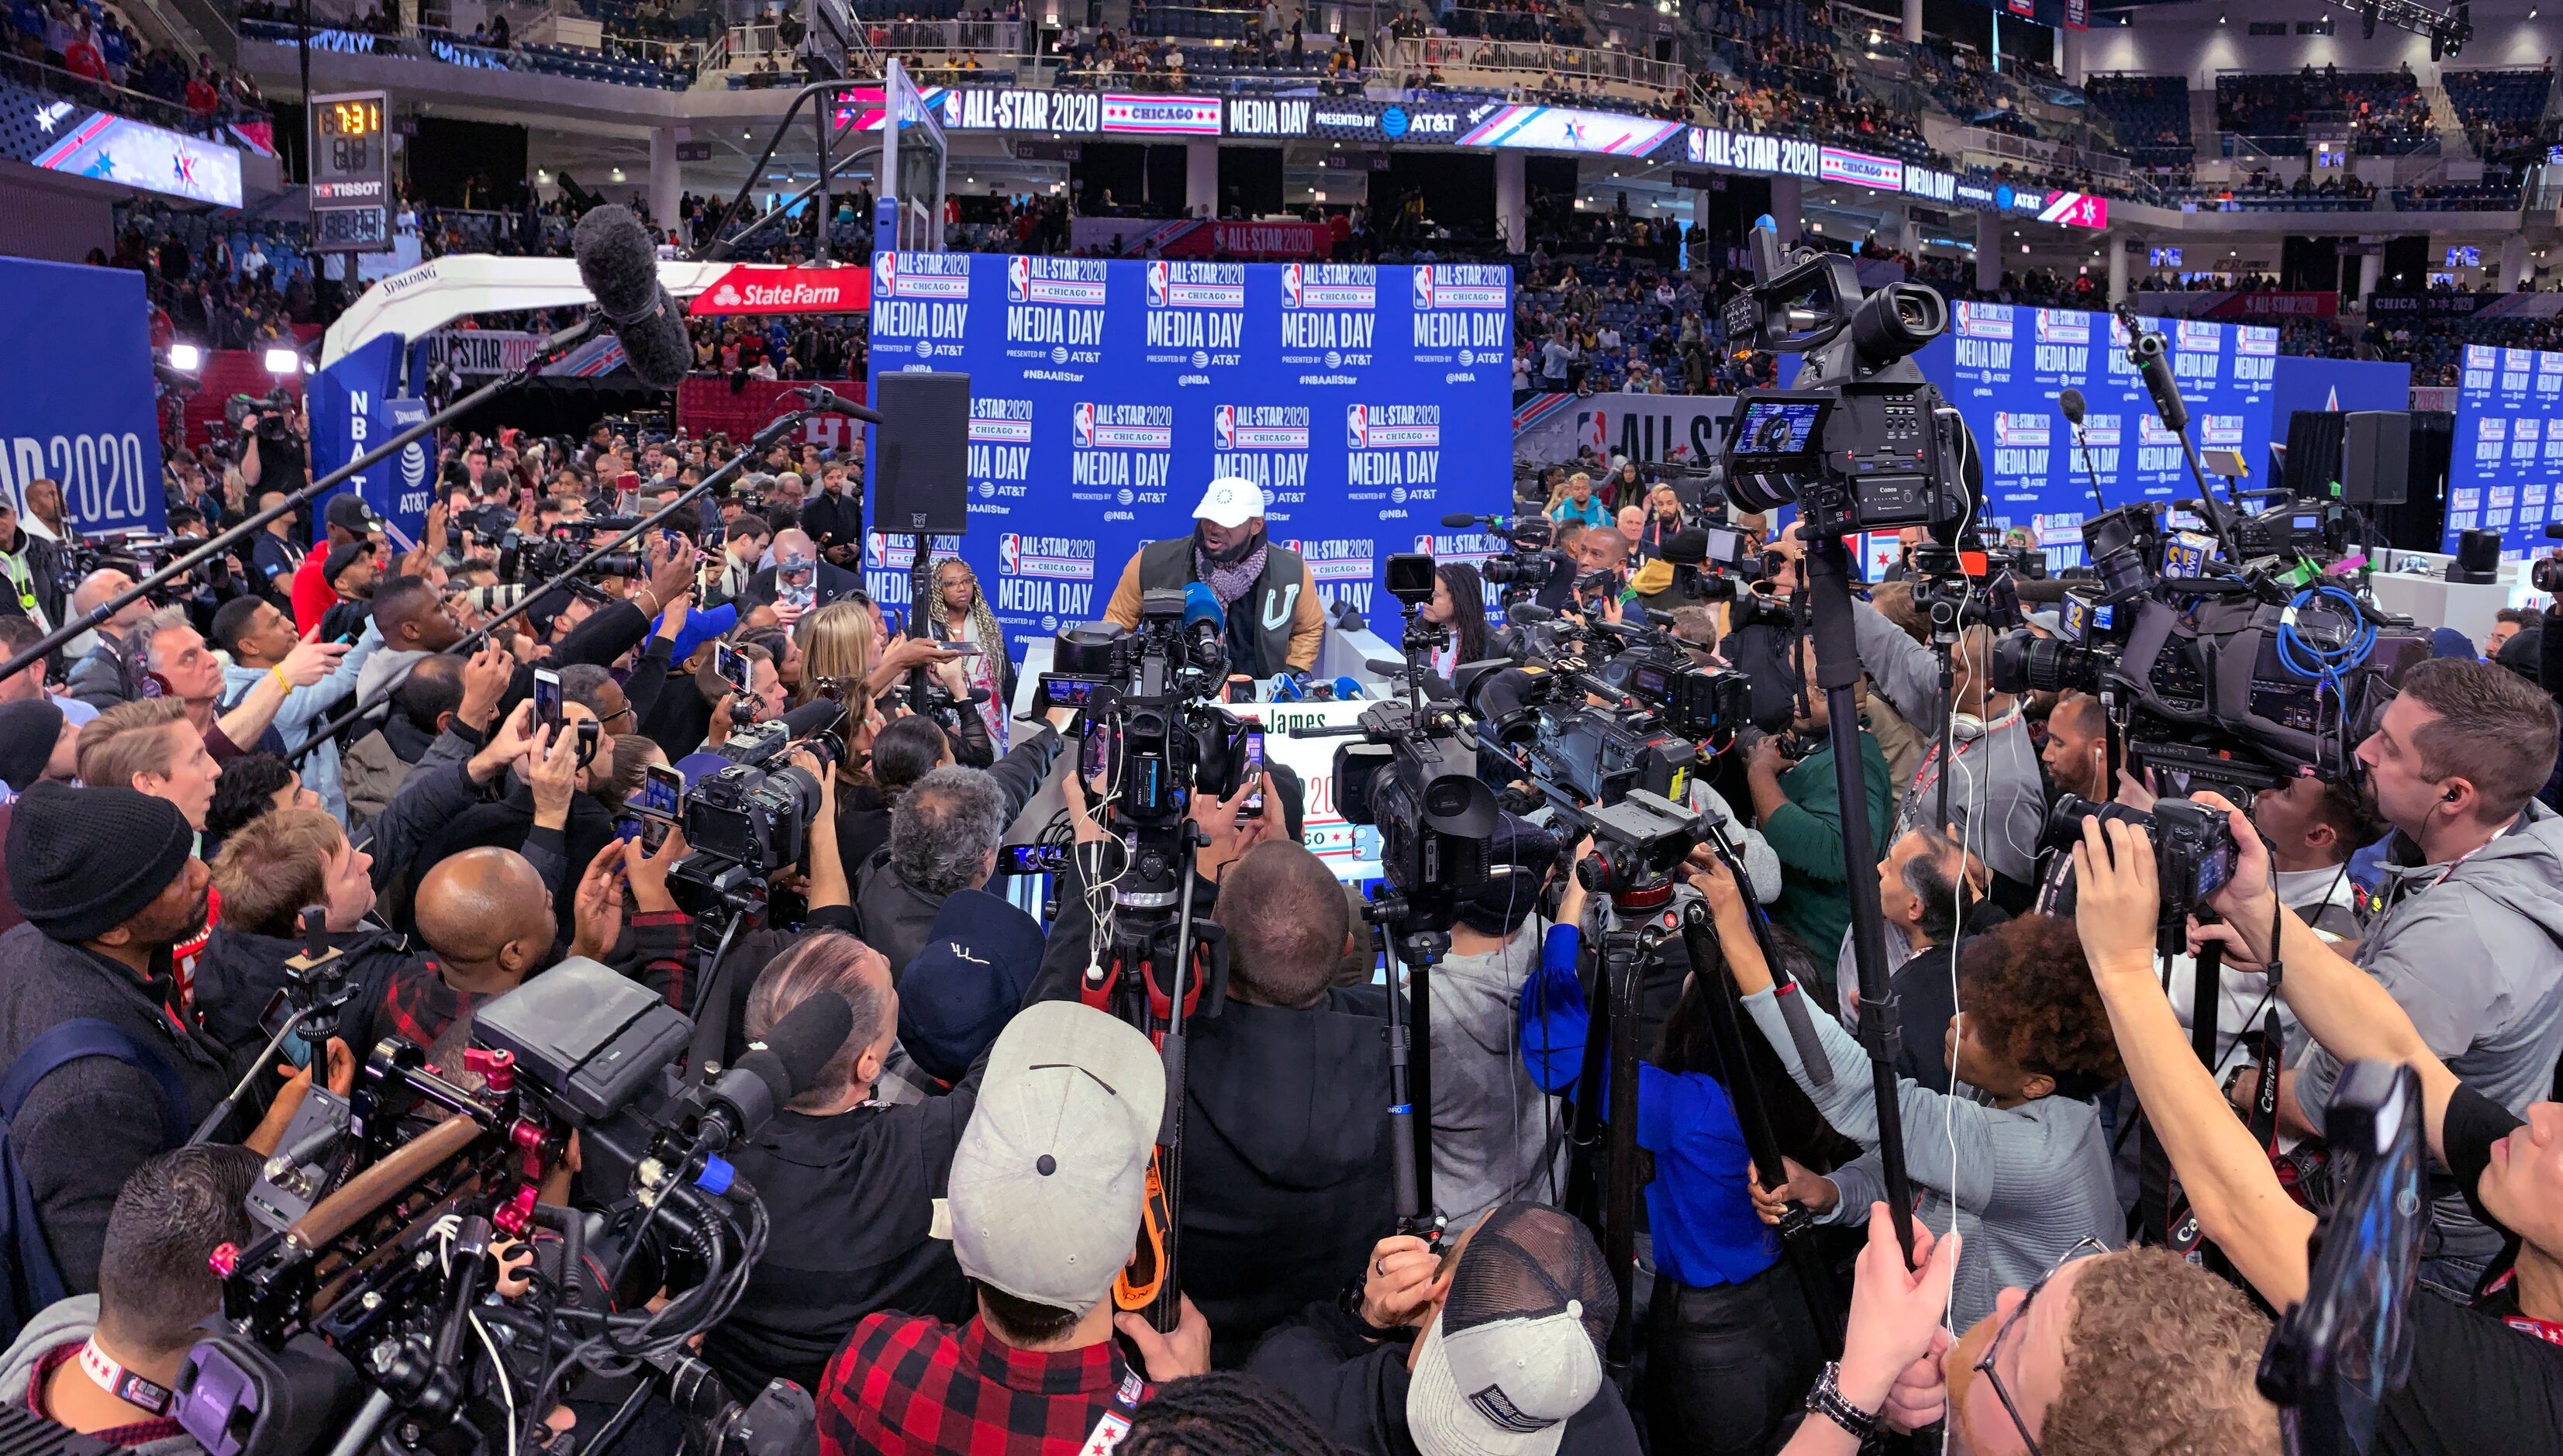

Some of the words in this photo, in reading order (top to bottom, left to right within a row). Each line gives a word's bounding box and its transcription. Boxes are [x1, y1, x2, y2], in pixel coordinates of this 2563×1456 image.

[1051, 93, 1098, 132] 2020
[1132, 106, 1194, 122] CHICAGO
[1231, 101, 1276, 133] MEDIA
[1279, 102, 1309, 133] DAY
[1316, 113, 1360, 127] PRESENTED
[1362, 115, 1375, 127] BY
[1410, 114, 1457, 132] AT&T
[1782, 140, 1818, 176] 2020
[1842, 161, 1882, 177] CHICAGO
[333, 181, 381, 196] TISSOT
[1905, 166, 1933, 197] MEDIA
[1935, 172, 1954, 201] DAY
[2014, 193, 2041, 209] AT&T
[1283, 229, 1313, 252] 2020
[944, 256, 969, 275] 2020
[1081, 261, 1106, 281] 2020
[1218, 264, 1244, 285] 2020
[1350, 265, 1376, 285] 2020
[1482, 265, 1506, 285] 2020
[384, 264, 437, 297] SPALDING
[913, 282, 950, 292] CHICAGO
[1048, 288, 1087, 298] CHICAGO
[1188, 292, 1226, 300] CHICAGO
[873, 301, 929, 337] MEDIA
[933, 304, 968, 338] DAY
[1007, 306, 1064, 343] MEDIA
[1068, 310, 1105, 346] DAY
[1147, 311, 1204, 347] MEDIA
[1209, 312, 1244, 349] DAY
[1282, 312, 1337, 347] MEDIA
[1341, 313, 1375, 348] DAY
[1414, 312, 1468, 347] MEDIA
[1472, 312, 1506, 347] DAY
[873, 344, 903, 354] PRESENTED
[934, 345, 964, 357] AT&T
[1006, 350, 1037, 359] PRESENTED
[1071, 352, 1101, 363] AT&T
[1476, 352, 1504, 364] AT&T
[1956, 338, 1989, 367] MEDIA
[1991, 341, 2013, 369] DAY
[2035, 345, 2068, 371] MEDIA
[2069, 347, 2089, 372] DAY
[1211, 354, 1240, 366] AT&T
[1344, 354, 1372, 366] AT&T
[2175, 353, 2201, 377] MEDIA
[2202, 354, 2219, 378] DAY
[1023, 370, 1084, 382] #NBAAllStar
[1178, 375, 1209, 386] @NBA
[1299, 375, 1357, 385] #NBAAllStar
[1446, 373, 1475, 383] @NBA
[1992, 374, 2011, 382] AT&T
[1973, 388, 1992, 397] @NBA
[1006, 400, 1033, 420] 2020
[1146, 406, 1172, 426] 2020
[1284, 407, 1309, 426] 2020
[1416, 405, 1440, 425] 2020
[995, 447, 1030, 481] DAY
[1348, 451, 1402, 485] MEDIA
[1406, 450, 1439, 484] DAY
[1995, 449, 2027, 474] MEDIA
[2029, 449, 2049, 474] DAY
[2101, 448, 2120, 472] DAY
[2138, 447, 2165, 471] MEDIA
[2165, 447, 2184, 470] DAY
[1073, 451, 1129, 485] MEDIA
[1136, 453, 1171, 487] DAY
[1214, 454, 1270, 486] MEDIA
[1275, 453, 1309, 487] DAY
[998, 486, 1026, 496] AT&T
[2031, 478, 2047, 487] AT&T
[400, 492, 429, 514] AT&T
[1138, 493, 1168, 502] AT&T
[1278, 492, 1306, 503] AT&T
[1409, 488, 1437, 500] AT&T
[1104, 512, 1135, 521] @NBA
[1379, 509, 1408, 520] @NBA
[1070, 540, 1095, 558] 2020
[1350, 539, 1374, 558] 2020
[2063, 545, 2082, 569] DAY
[1039, 563, 1076, 572] CHICAGO
[1319, 565, 1356, 574] CHICAGO
[999, 578, 1053, 612] MEDIA
[1059, 583, 1093, 616] DAY
[1265, 709, 1326, 733] James
[2261, 1057, 2276, 1113] Canon
